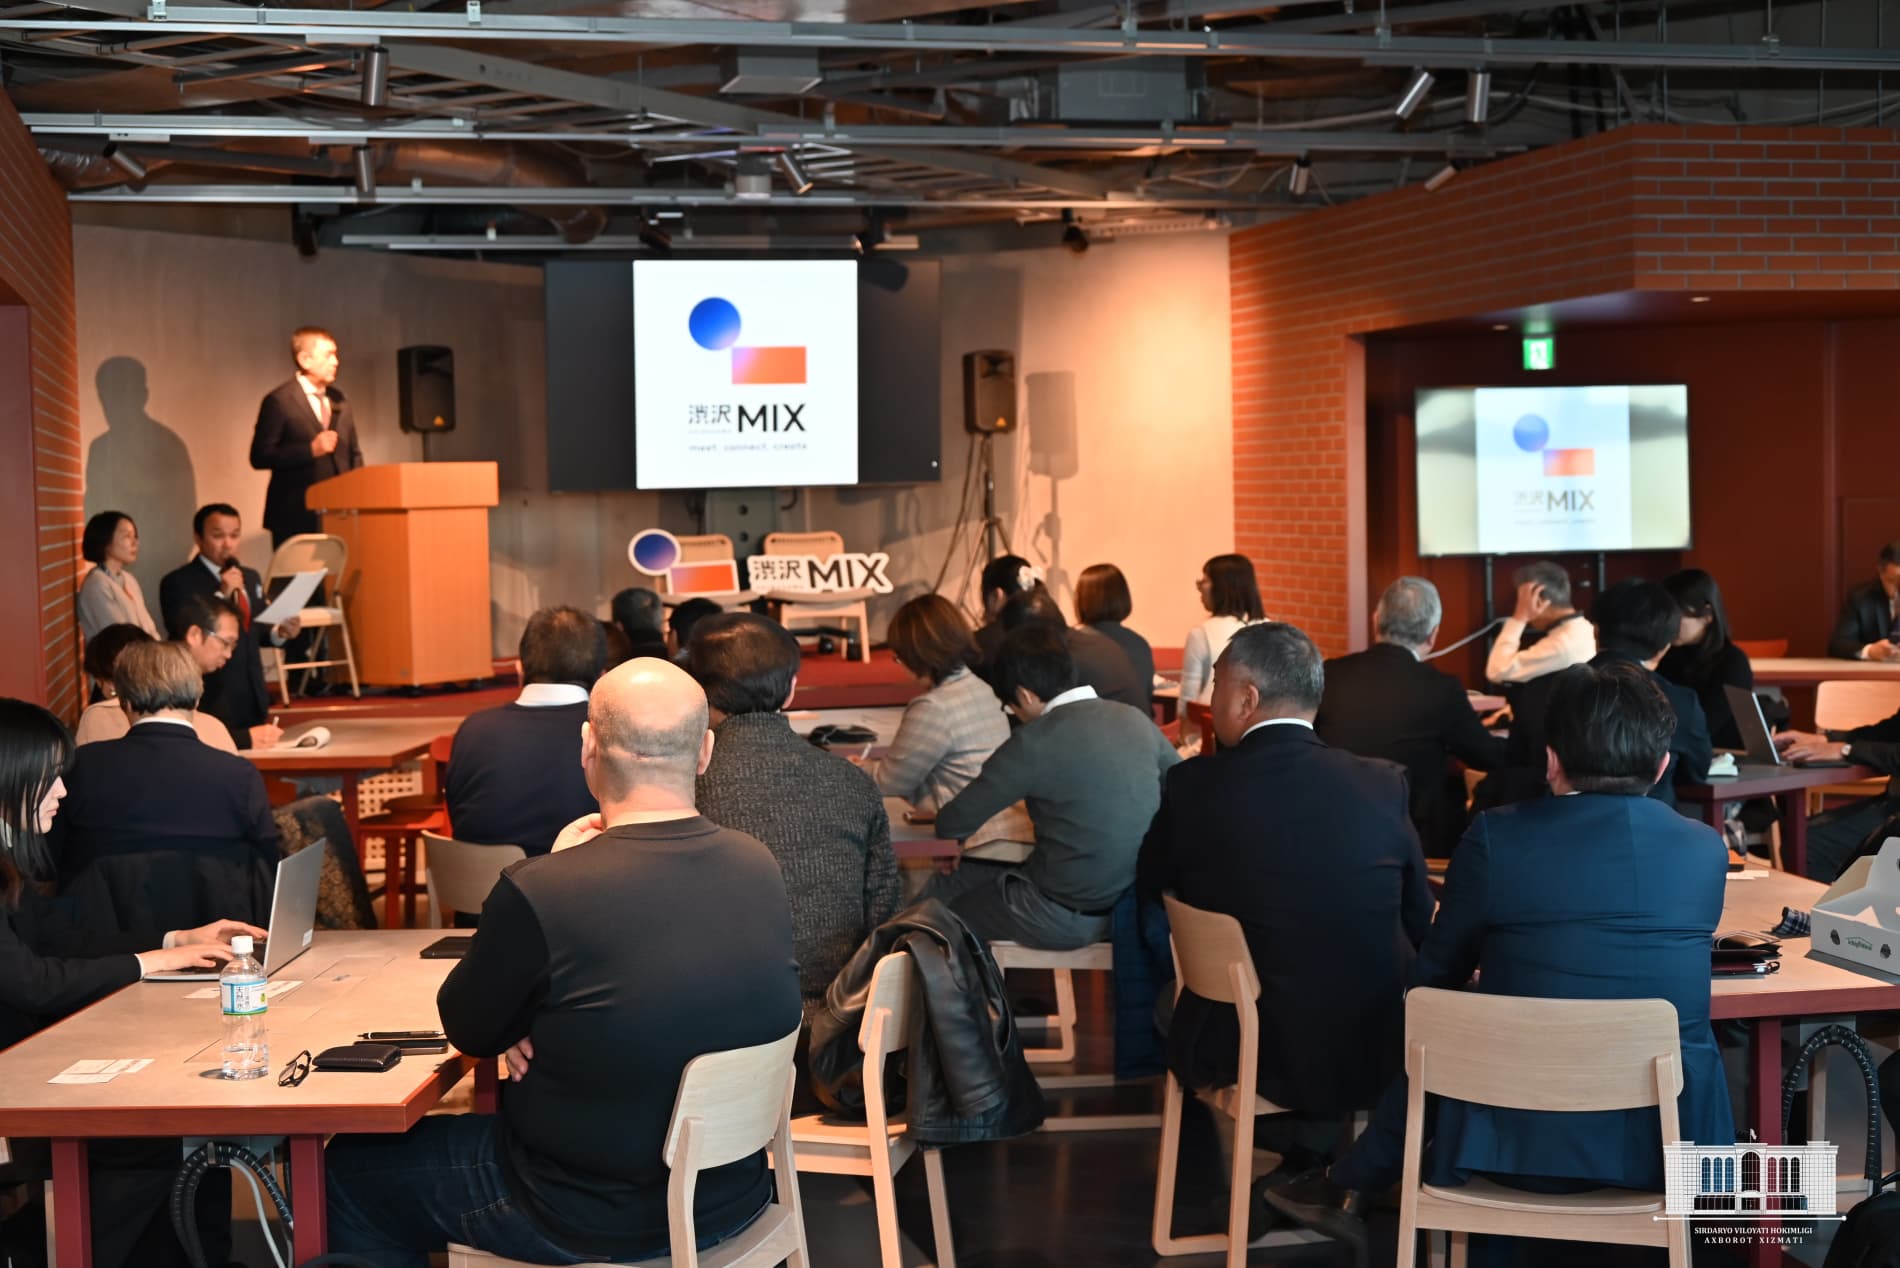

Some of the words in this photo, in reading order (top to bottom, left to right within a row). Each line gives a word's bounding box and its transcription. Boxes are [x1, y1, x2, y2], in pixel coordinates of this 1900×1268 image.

[688, 403, 731, 425] 渋沢
[737, 403, 806, 433] MIX
[1547, 489, 1595, 512] MIX
[753, 559, 802, 580] 渋沢
[807, 559, 885, 589] MIX
